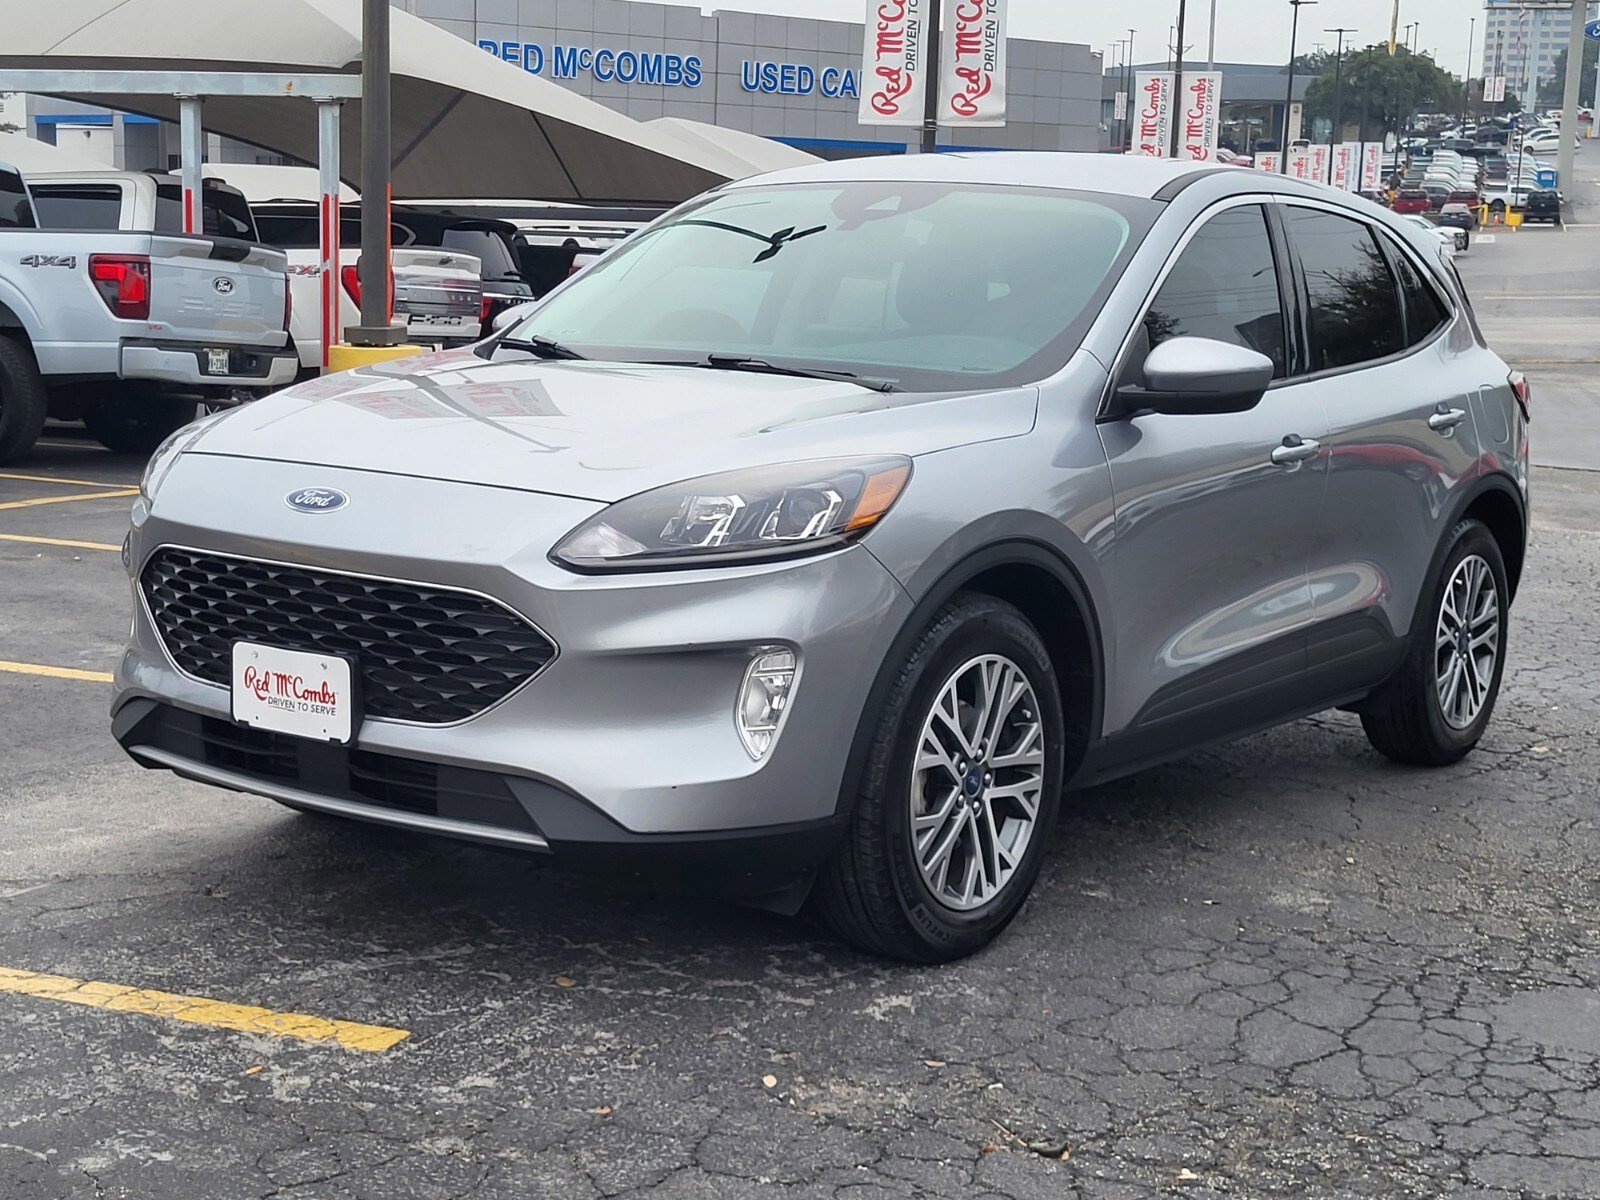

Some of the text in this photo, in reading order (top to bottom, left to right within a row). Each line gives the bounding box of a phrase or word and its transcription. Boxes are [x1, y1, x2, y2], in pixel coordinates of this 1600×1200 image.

[905, 20, 920, 72] DRIVEN
[984, 20, 999, 72] DRIVEN
[741, 60, 815, 95] USED
[820, 66, 863, 98] CA
[871, 66, 912, 115] Red
[951, 66, 991, 116] Red
[1140, 77, 1161, 141] McCombs
[1157, 118, 1167, 147] DRIVEN
[1159, 104, 1167, 115] TO
[1186, 77, 1208, 161] ed McCombs
[1203, 77, 1215, 148] DRIVEN TO SERVE
[295, 489, 335, 507] Ford
[244, 665, 337, 706] Red McCombs
[267, 696, 337, 716] DRIVEN TO SERVE
